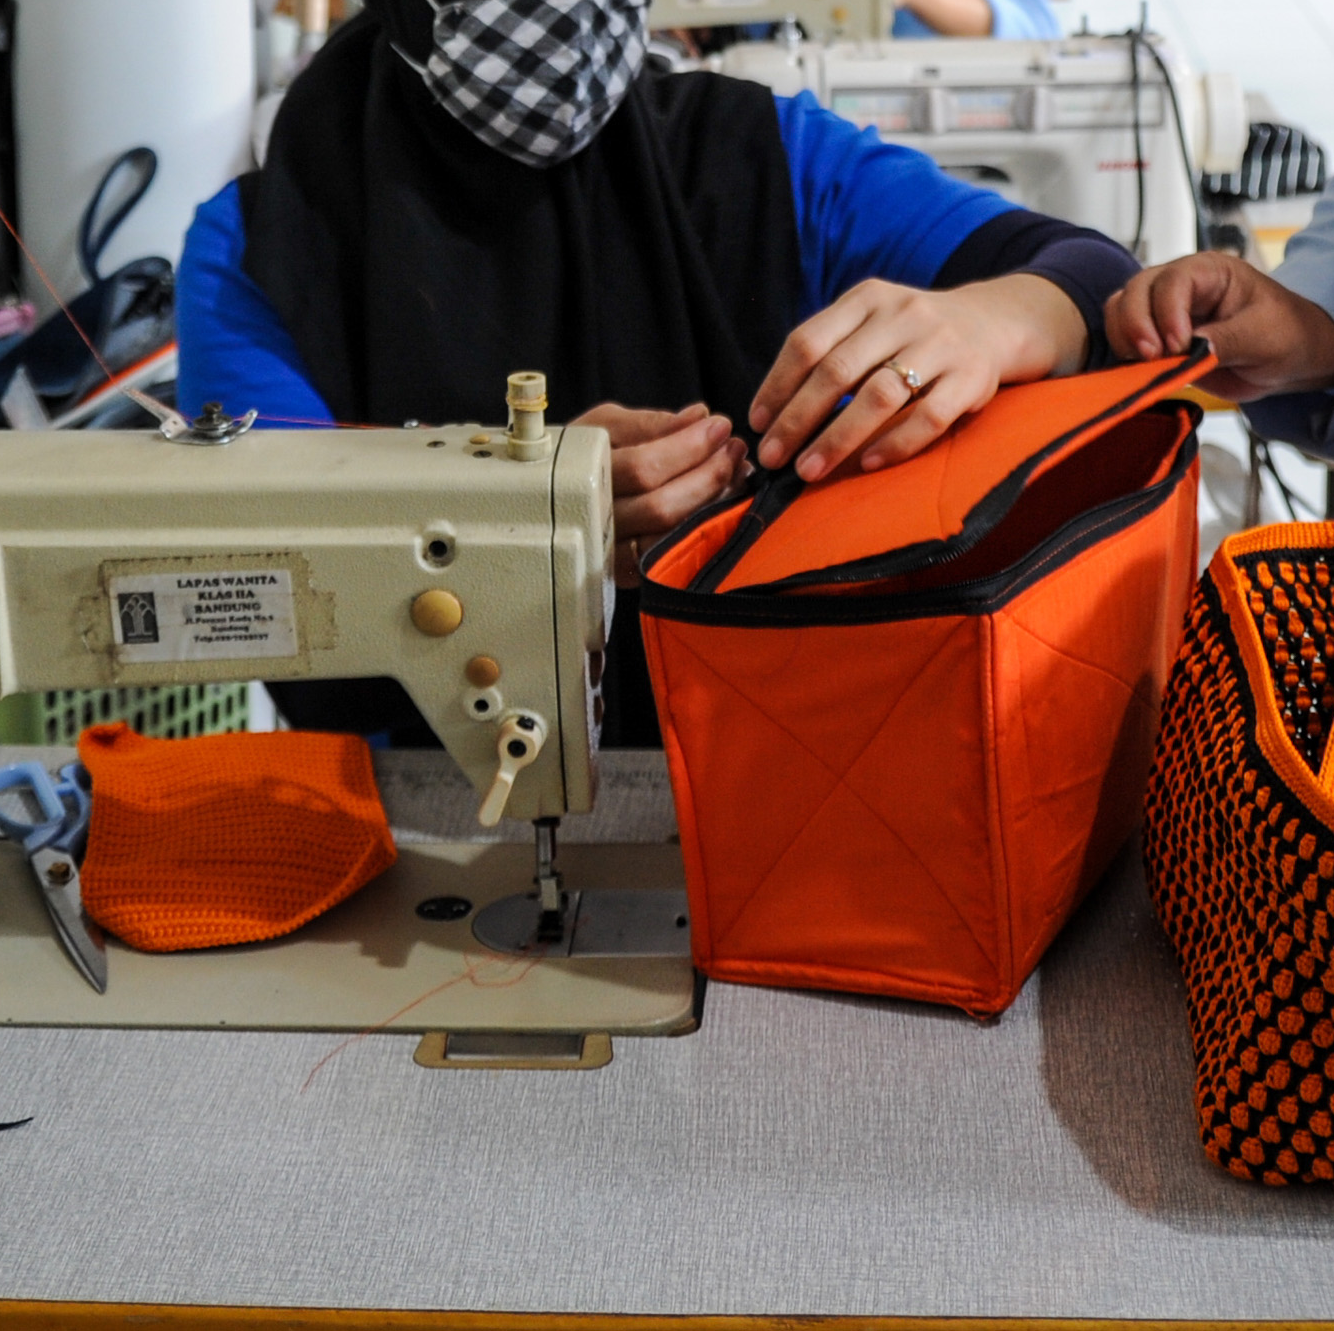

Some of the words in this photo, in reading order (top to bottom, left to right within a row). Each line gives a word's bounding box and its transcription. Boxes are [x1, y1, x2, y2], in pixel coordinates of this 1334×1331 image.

[177, 577, 220, 589] LAPAS
[222, 575, 278, 587] WANITA
[198, 590, 233, 601] KLAS
[193, 602, 262, 615] BANDUNG
